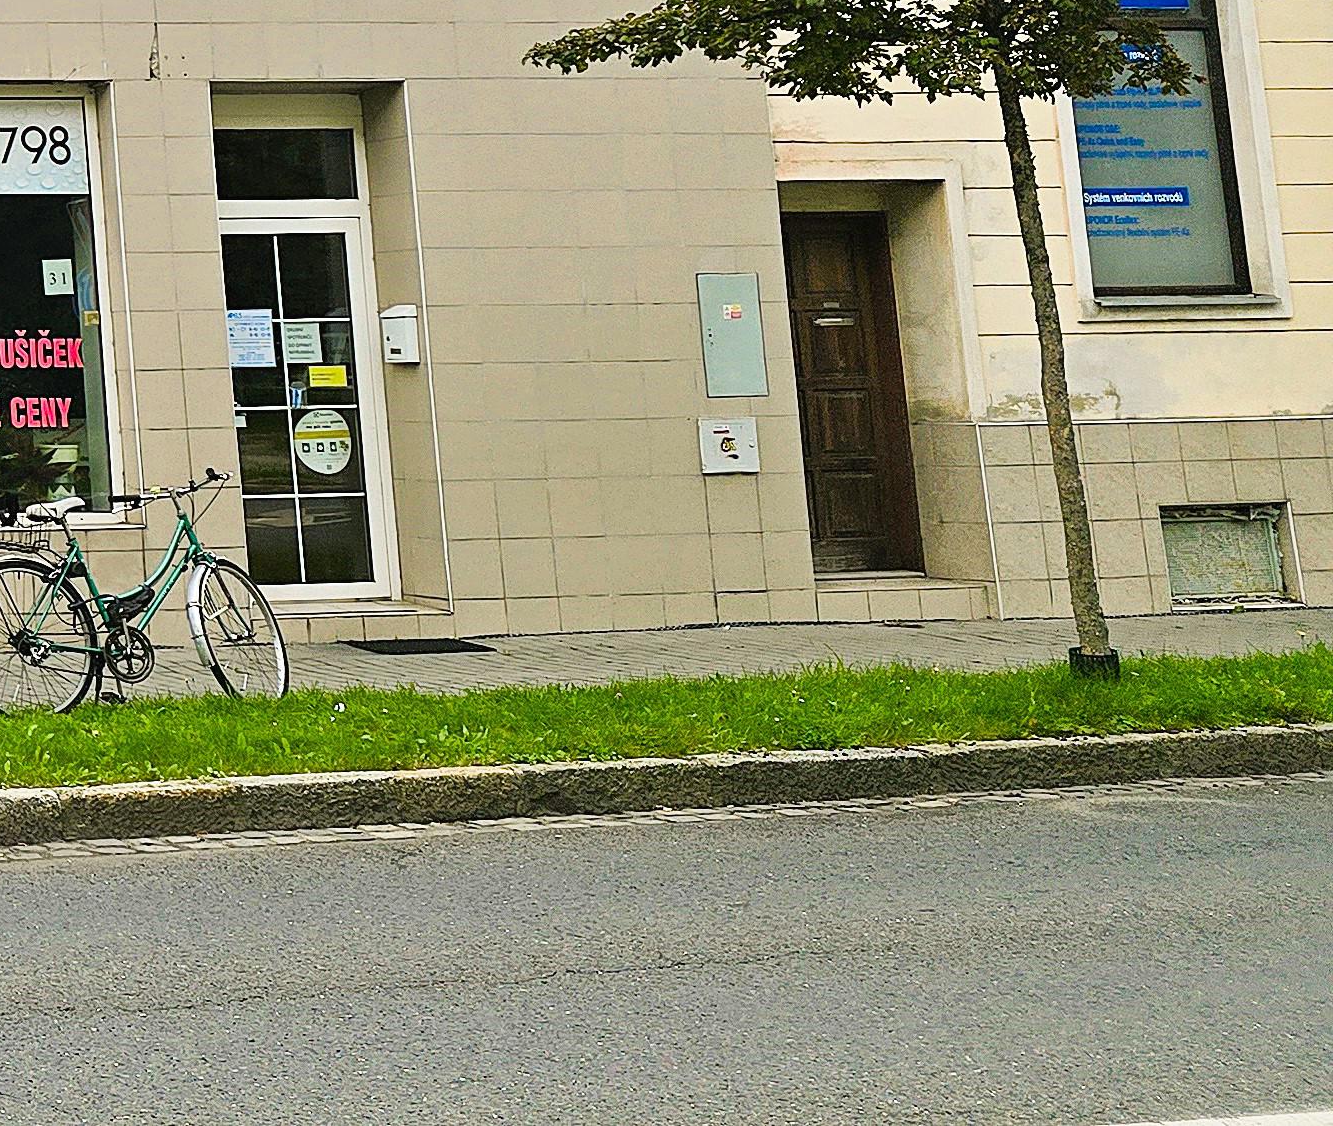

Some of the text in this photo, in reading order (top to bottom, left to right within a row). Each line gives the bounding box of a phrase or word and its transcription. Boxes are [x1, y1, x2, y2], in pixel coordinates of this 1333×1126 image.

[1084, 192, 1110, 205] Systém
[48, 272, 68, 286] 31
[9, 397, 72, 429] CENY
